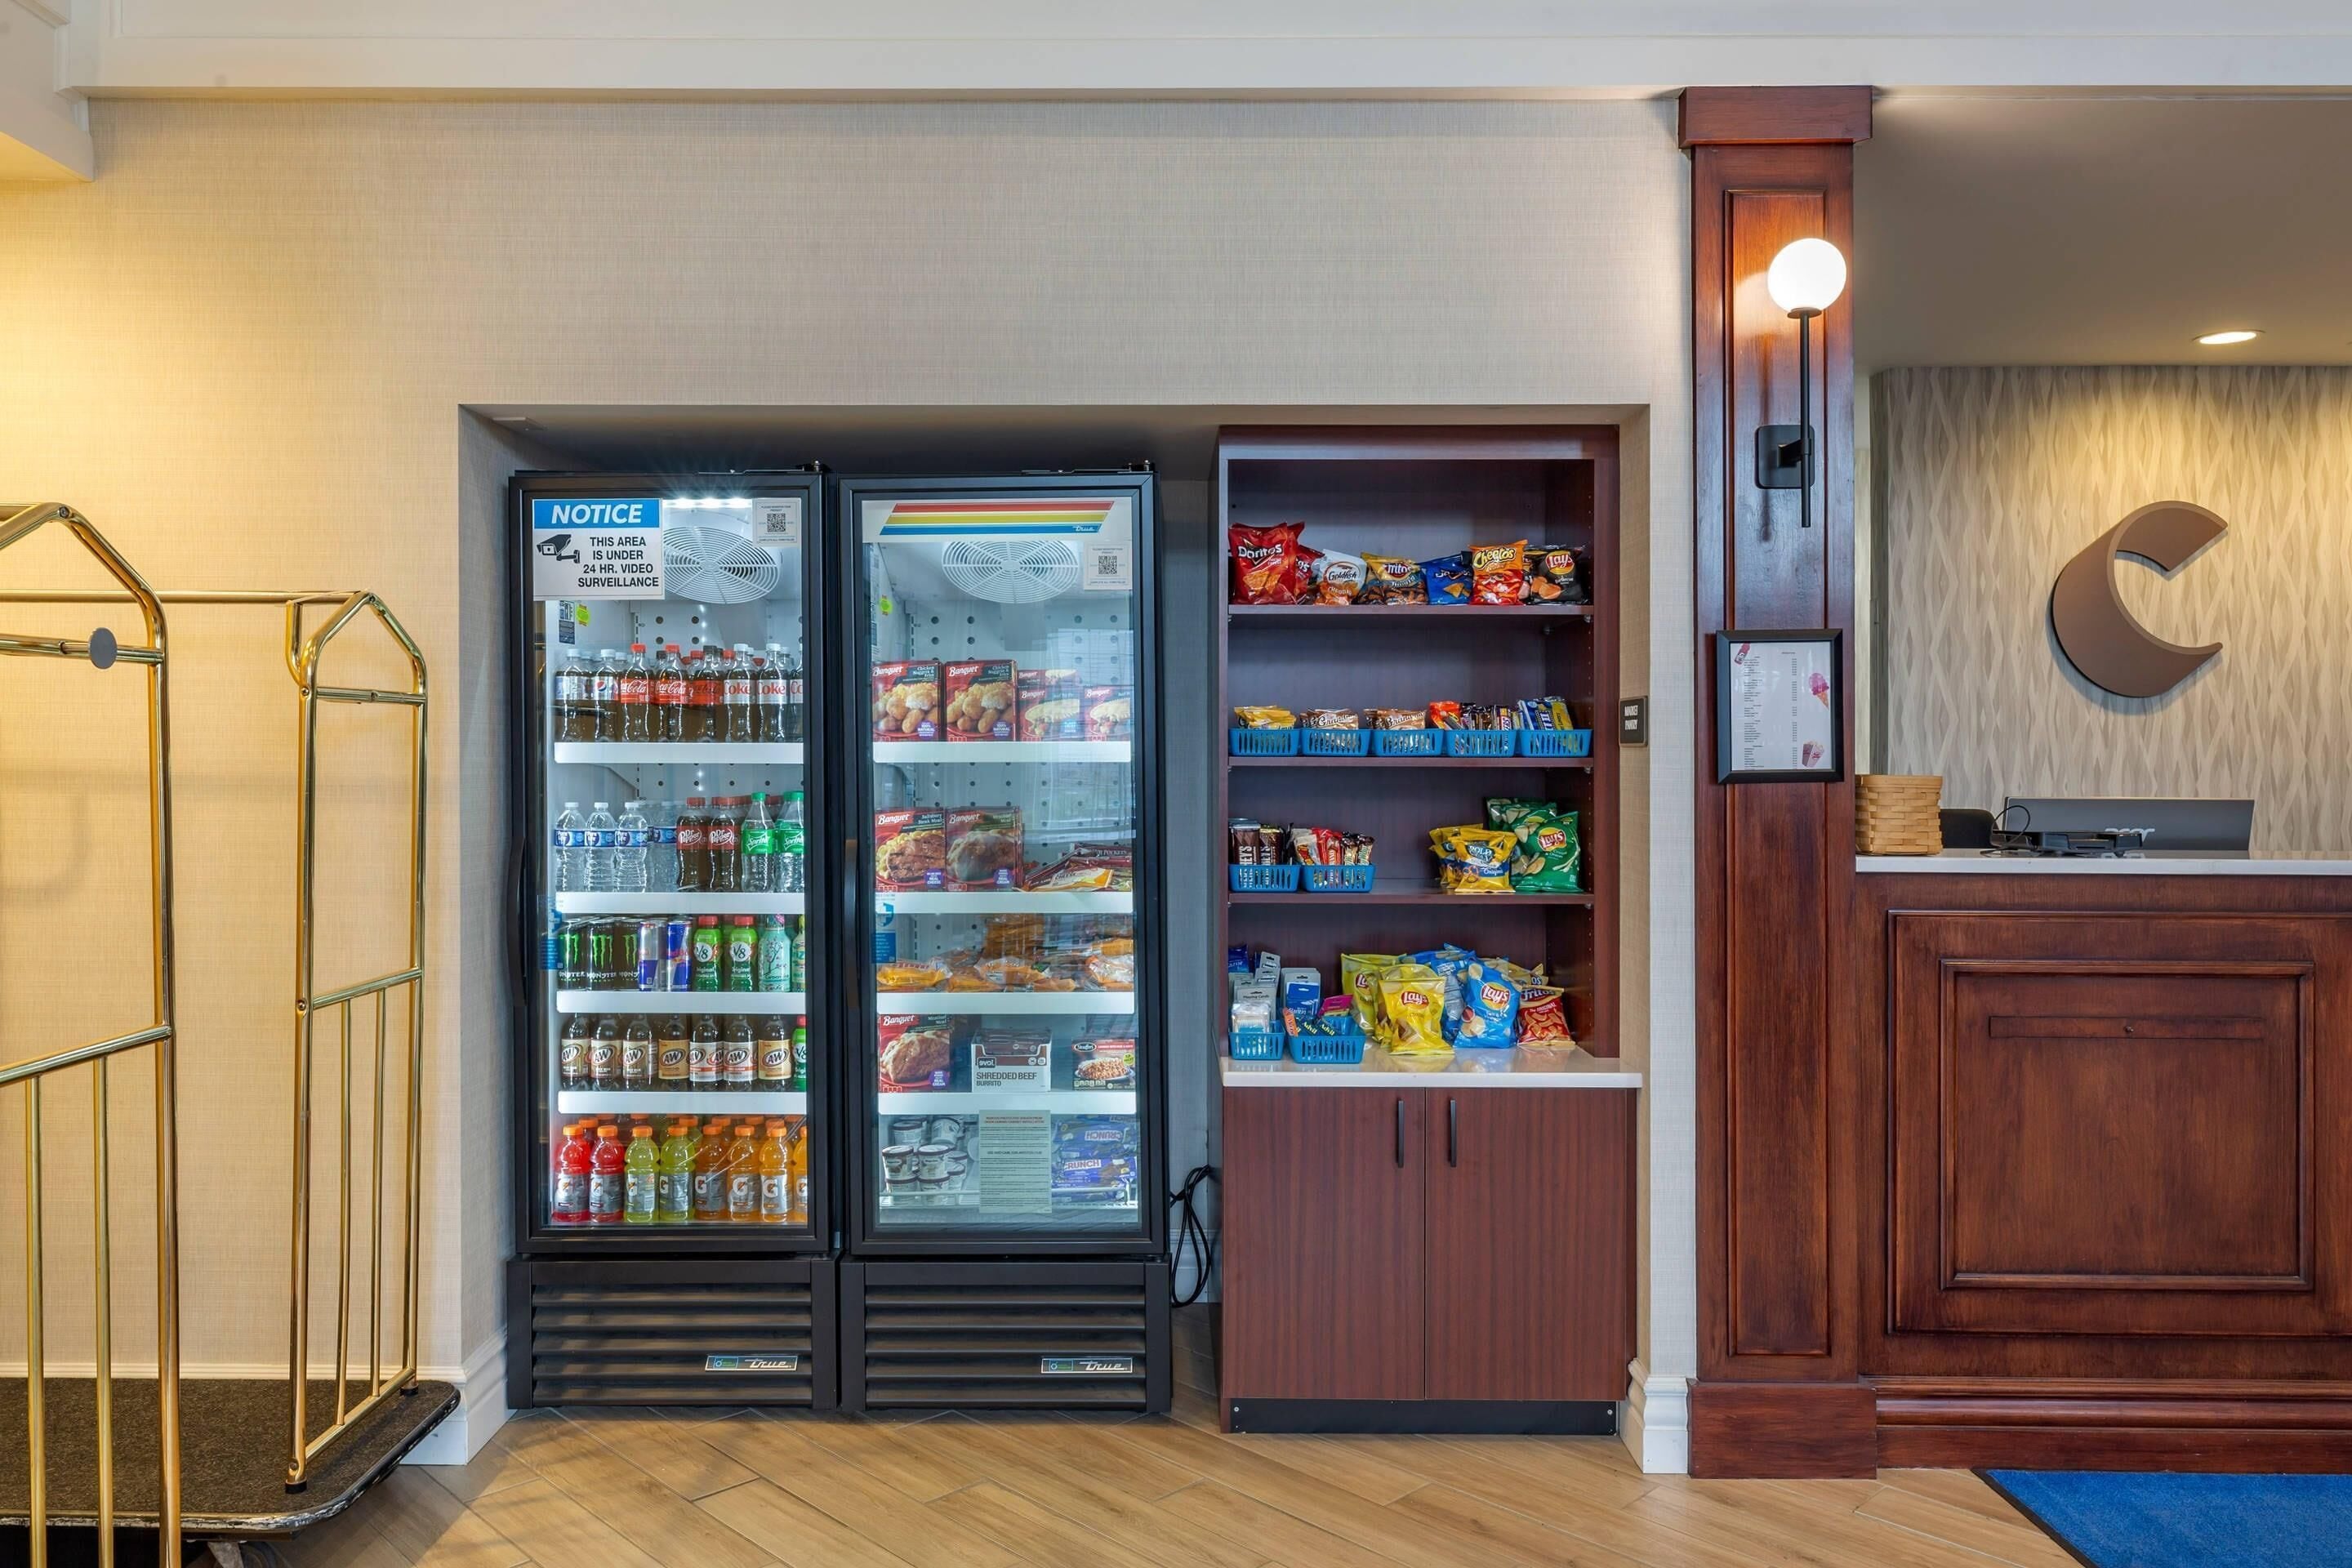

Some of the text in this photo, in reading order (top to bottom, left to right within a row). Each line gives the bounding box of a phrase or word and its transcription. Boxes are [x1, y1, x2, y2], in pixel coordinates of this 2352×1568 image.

[551, 504, 644, 524] NOTICE
[590, 537, 646, 546] THIS AREA
[593, 550, 644, 560] IS UNDER
[1238, 543, 1282, 559] Doritos
[1472, 547, 1516, 568] Cheetos
[583, 564, 653, 574] 24 HR. VIDEO
[577, 577, 659, 587] SURVEILLANCE
[1328, 571, 1356, 581] Goldfish
[873, 666, 903, 676] Banquet
[949, 666, 978, 677] Banquet
[724, 681, 750, 695] Coke
[757, 681, 786, 695] Coke
[878, 813, 910, 825] Banquet
[949, 813, 980, 825] Banquet
[679, 830, 701, 844] Pepper
[710, 830, 731, 844] Pepper
[733, 943, 746, 960] V8
[1521, 989, 1555, 1001] Fritos
[883, 1015, 915, 1027] Banquet
[976, 1071, 1037, 1080] SHREDDED BEEF
[1064, 1159, 1100, 1169] CRUNCH
[733, 1176, 749, 1196] G
[763, 1178, 778, 1198] G
